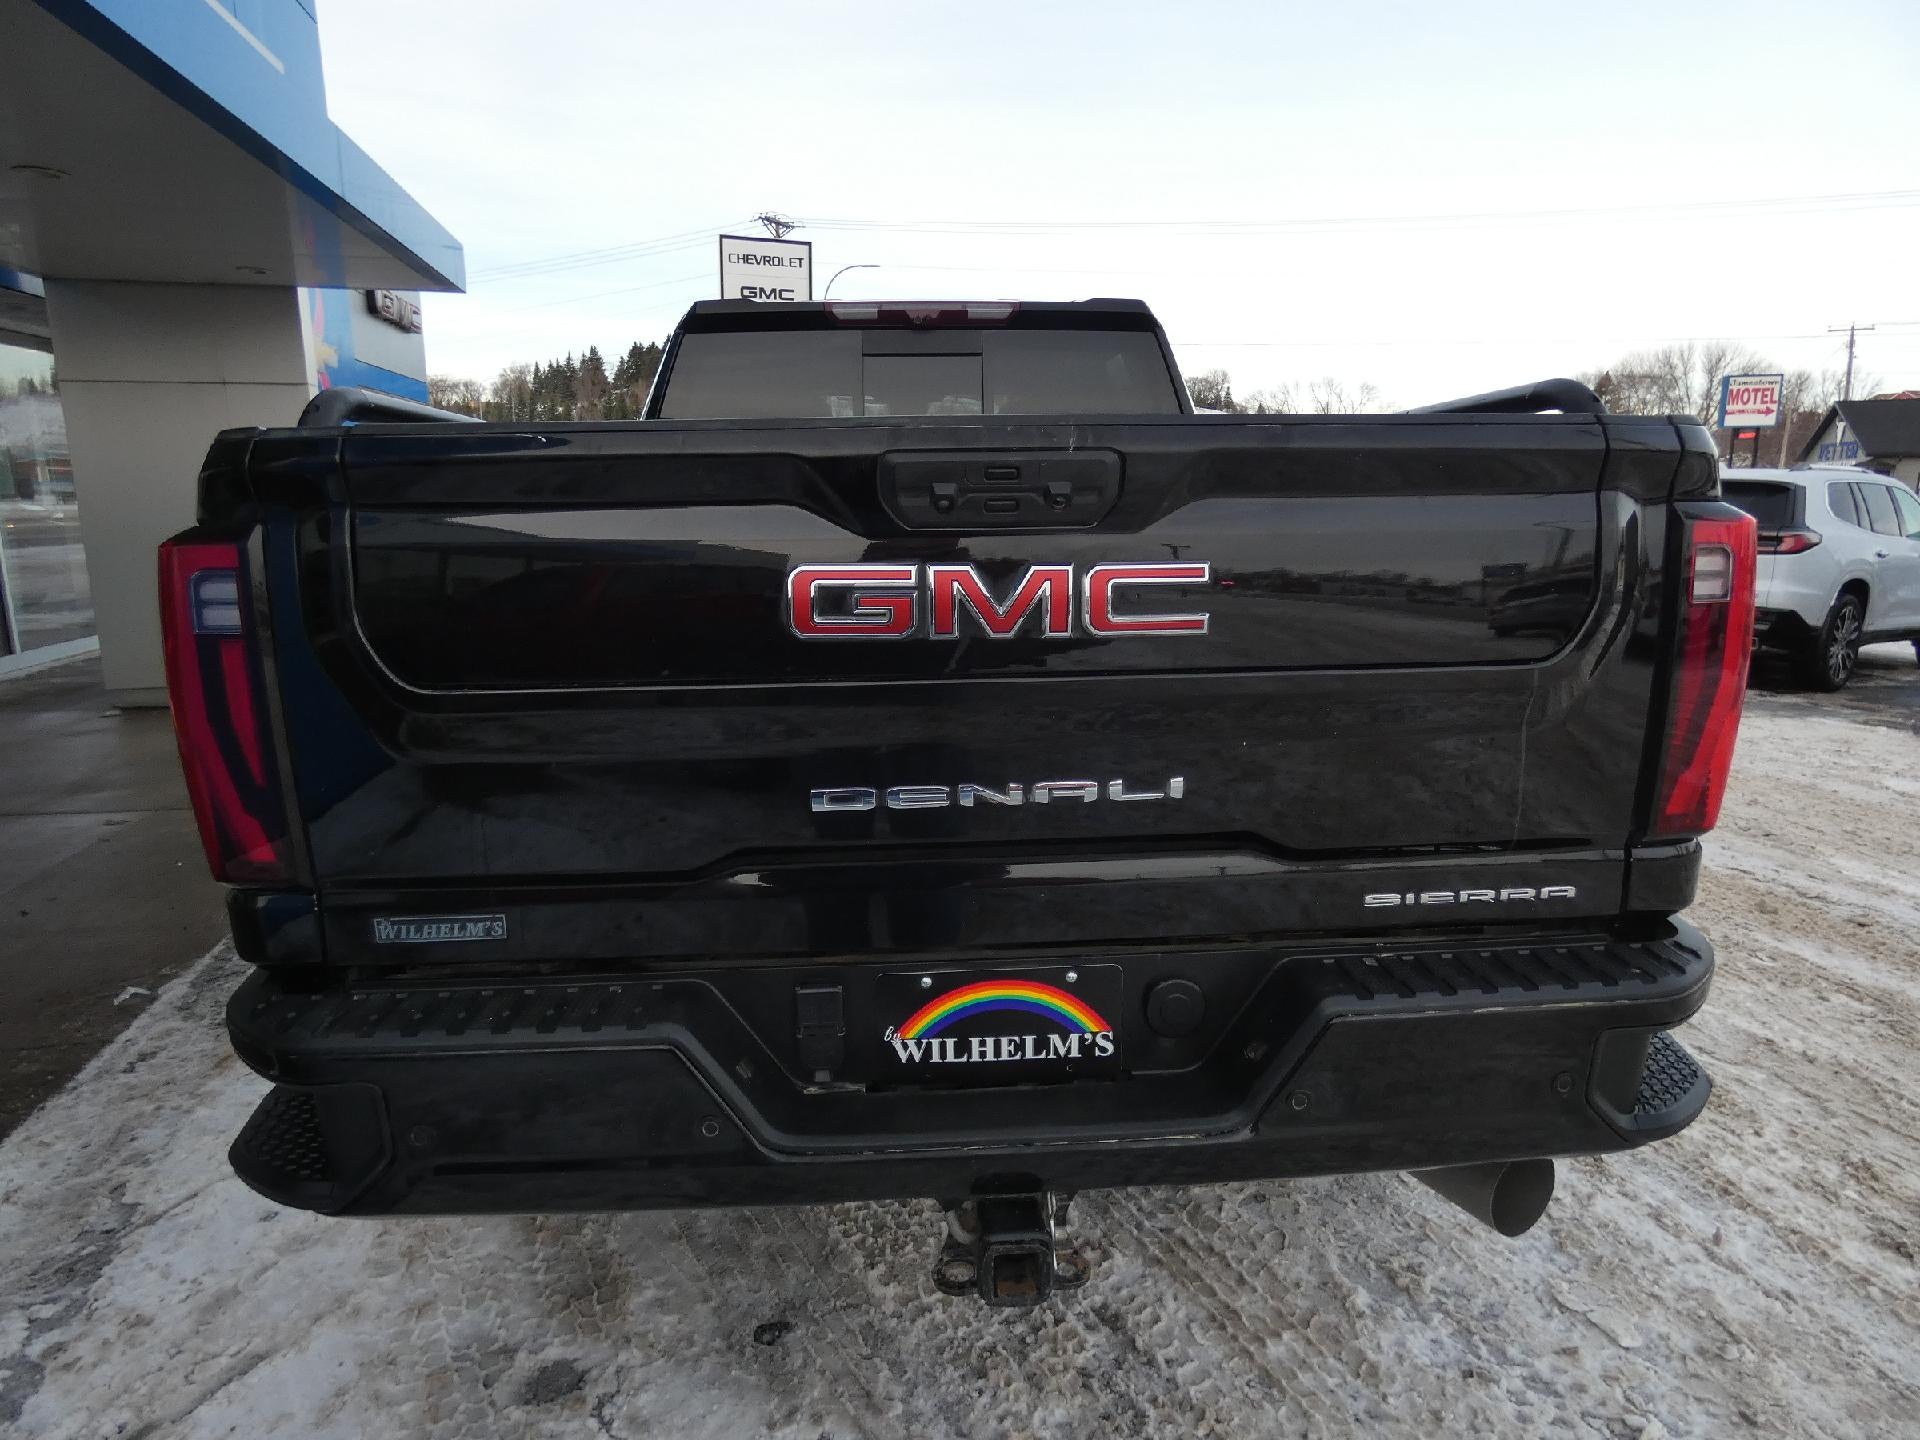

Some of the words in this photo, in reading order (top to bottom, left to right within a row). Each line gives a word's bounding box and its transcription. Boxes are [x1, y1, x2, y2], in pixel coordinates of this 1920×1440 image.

[729, 253, 804, 268] CHEVROLET
[741, 286, 794, 301] GMC
[1727, 387, 1778, 406] MOTEL
[788, 562, 1209, 638] GMC
[810, 777, 1184, 812] DENALI
[1364, 885, 1576, 907] SIERRA
[379, 921, 503, 940] WILHELM'S
[892, 1031, 1115, 1063] WILHELM'S
